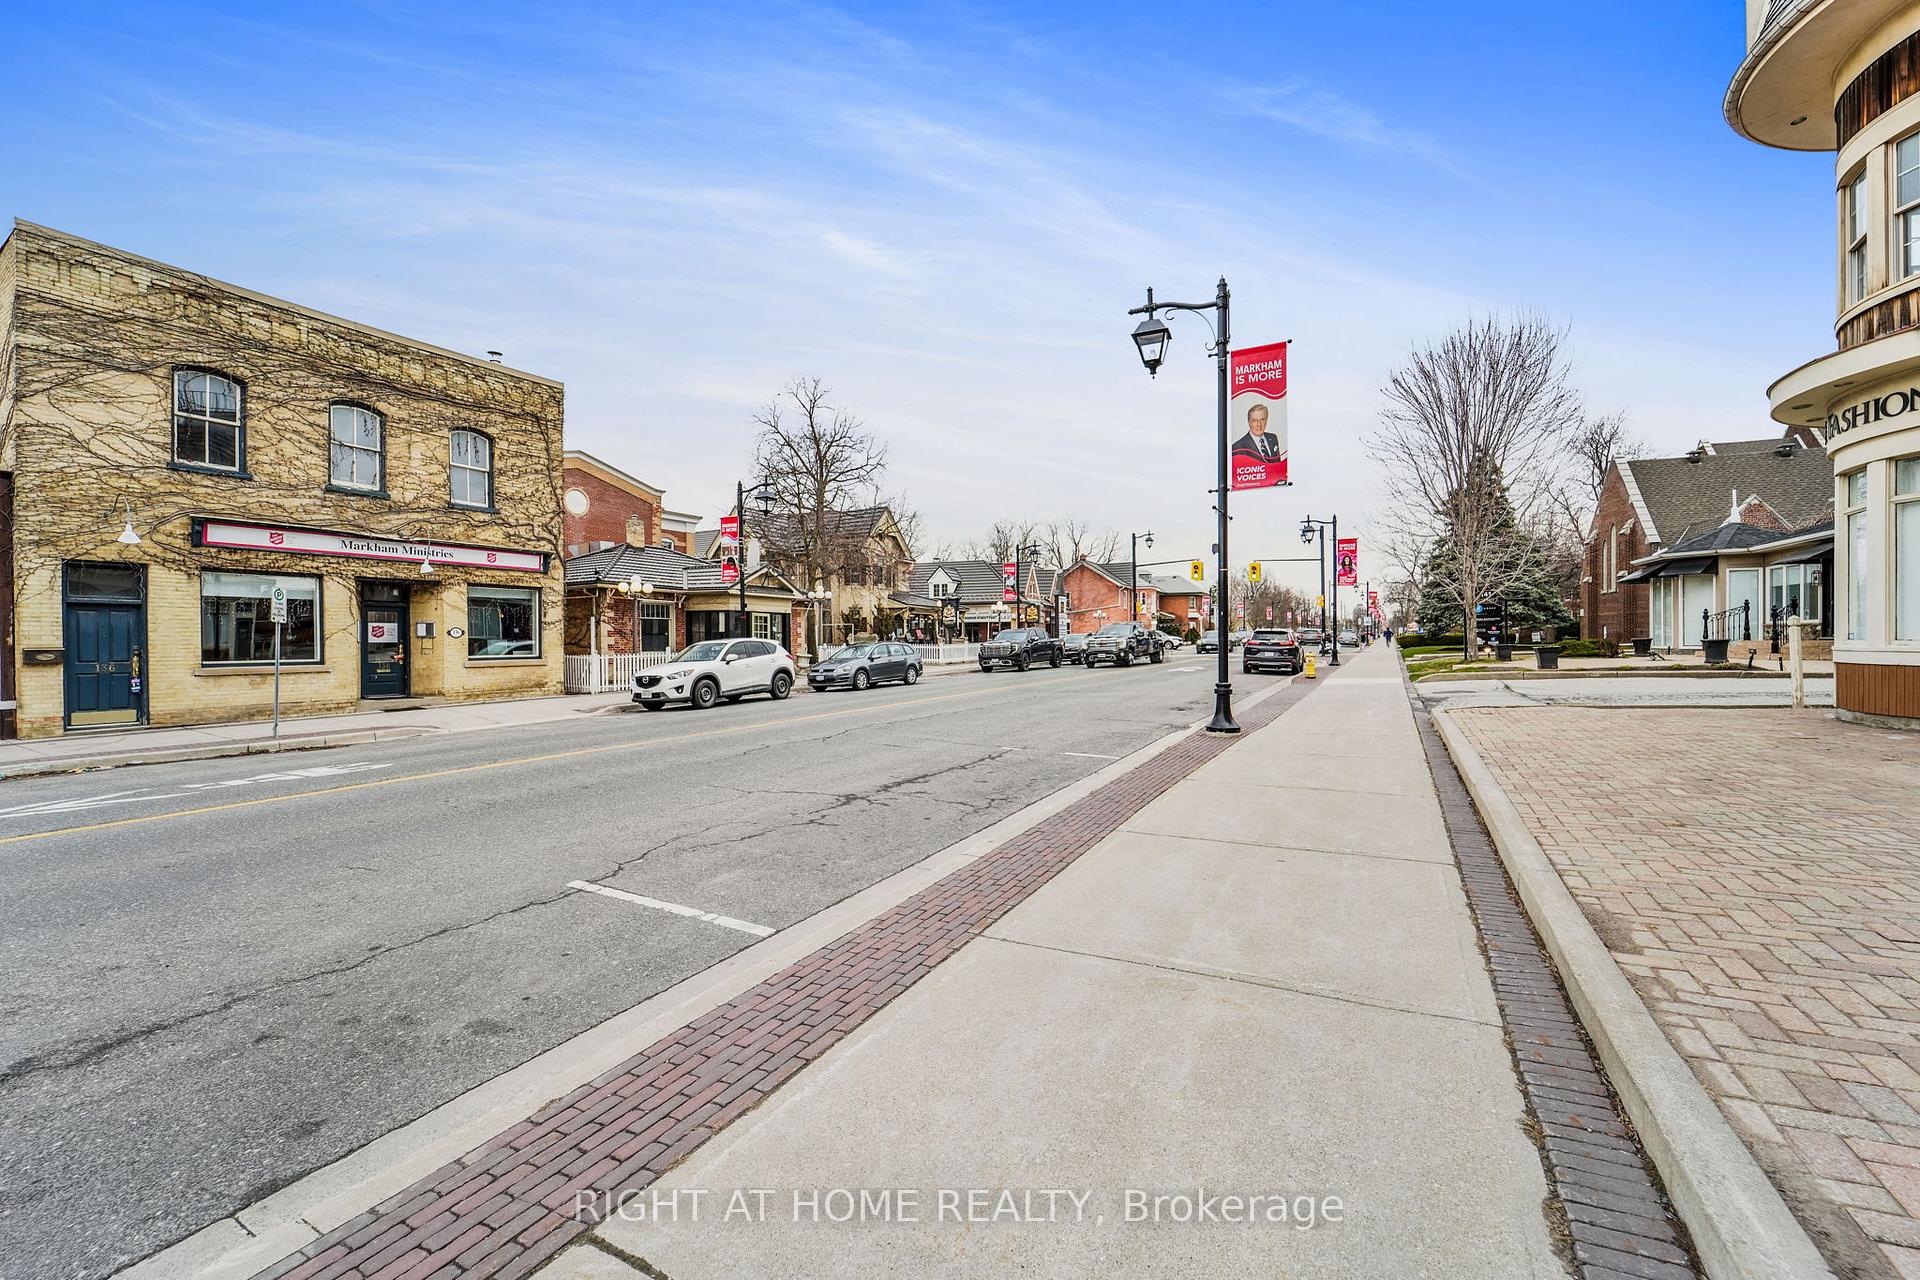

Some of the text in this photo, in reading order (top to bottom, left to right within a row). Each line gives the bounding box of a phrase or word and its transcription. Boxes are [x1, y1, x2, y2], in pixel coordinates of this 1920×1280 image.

[1235, 359, 1283, 375] MARKHAM
[1235, 370, 1283, 385] IS MORE
[1236, 465, 1266, 475] ICONIC
[1236, 472, 1267, 482] VOICES
[340, 540, 455, 559] Markham Ministries
[95, 664, 116, 673] 136
